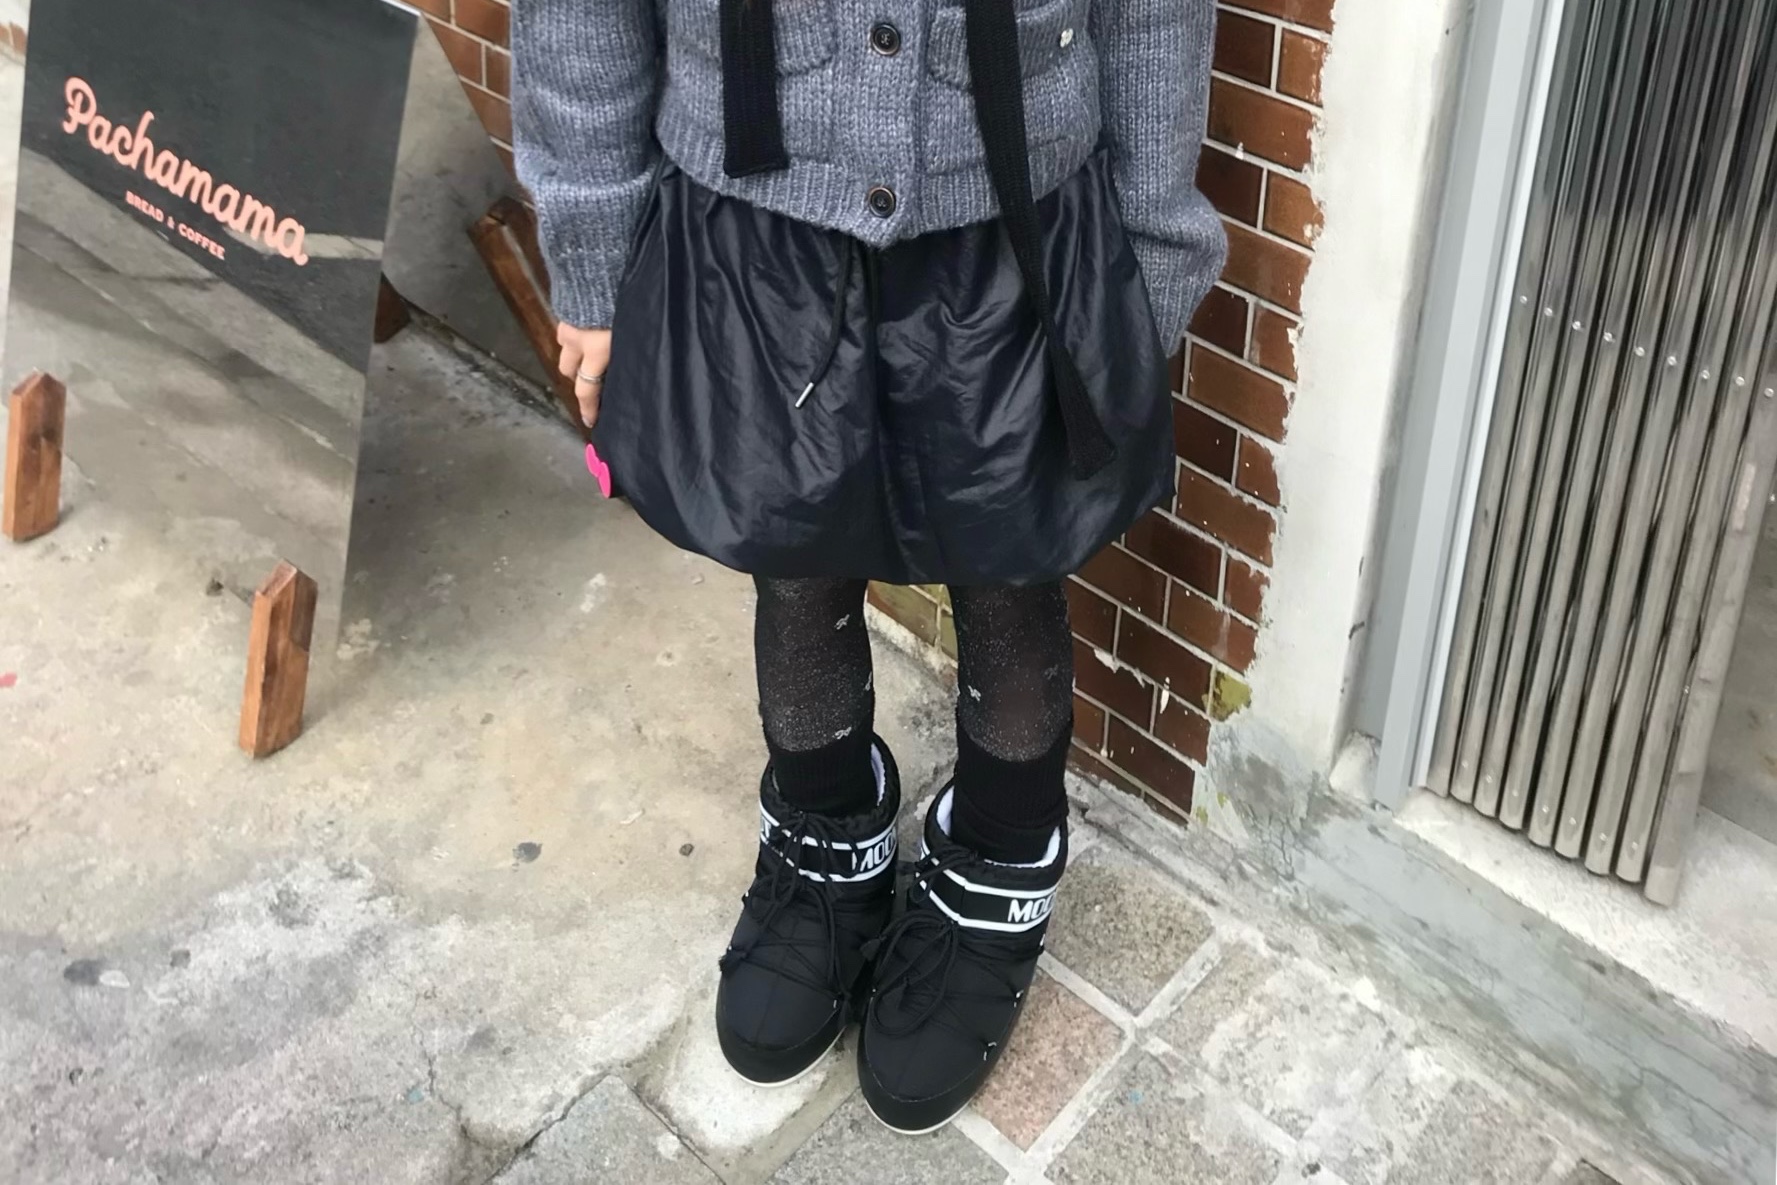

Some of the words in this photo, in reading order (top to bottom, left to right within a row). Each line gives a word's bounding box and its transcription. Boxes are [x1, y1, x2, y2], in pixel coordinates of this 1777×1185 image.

[63, 77, 308, 266] Pachamama
[126, 190, 164, 223] BREAD
[167, 216, 175, 229] &
[178, 223, 226, 261] COFFEE
